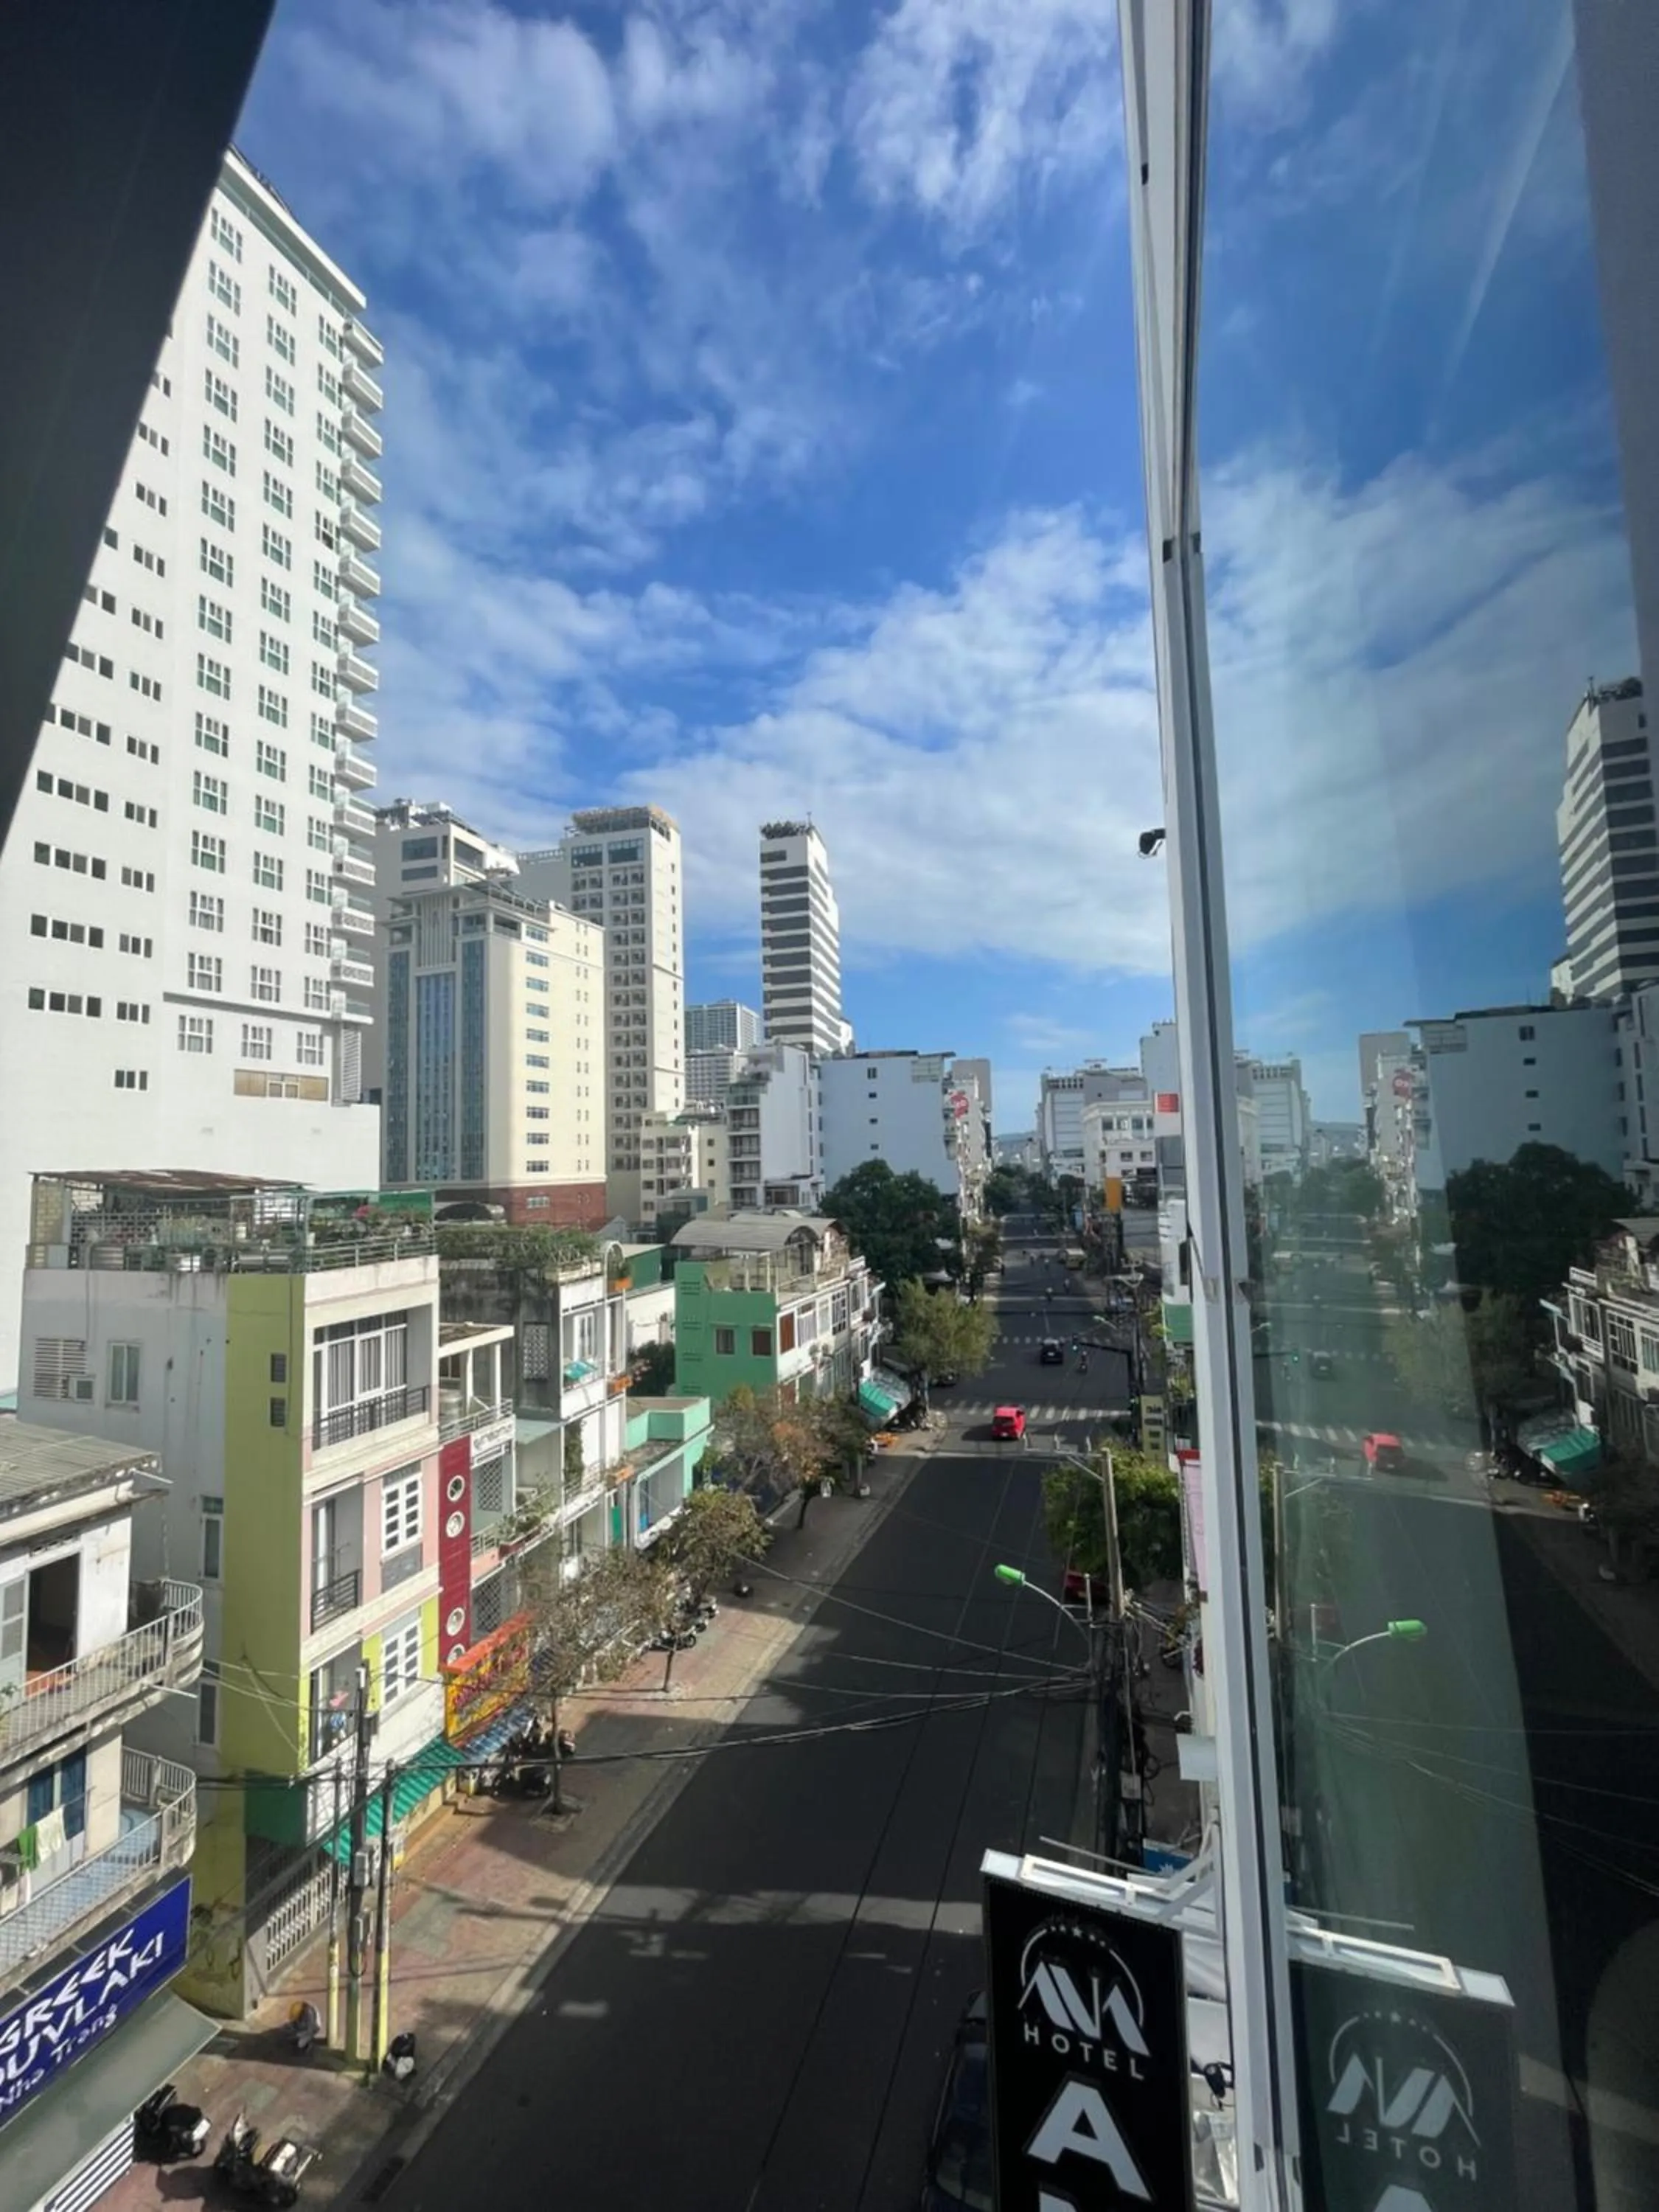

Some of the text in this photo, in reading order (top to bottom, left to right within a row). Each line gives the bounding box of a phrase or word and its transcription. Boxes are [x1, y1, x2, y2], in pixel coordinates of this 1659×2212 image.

[0, 1928, 134, 2056] GREEK
[0, 1932, 164, 2086] UVLAKI
[49, 2003, 117, 2064] Trang
[1023, 2022, 1145, 2081] HOTEL
[1027, 2079, 1152, 2212] A
